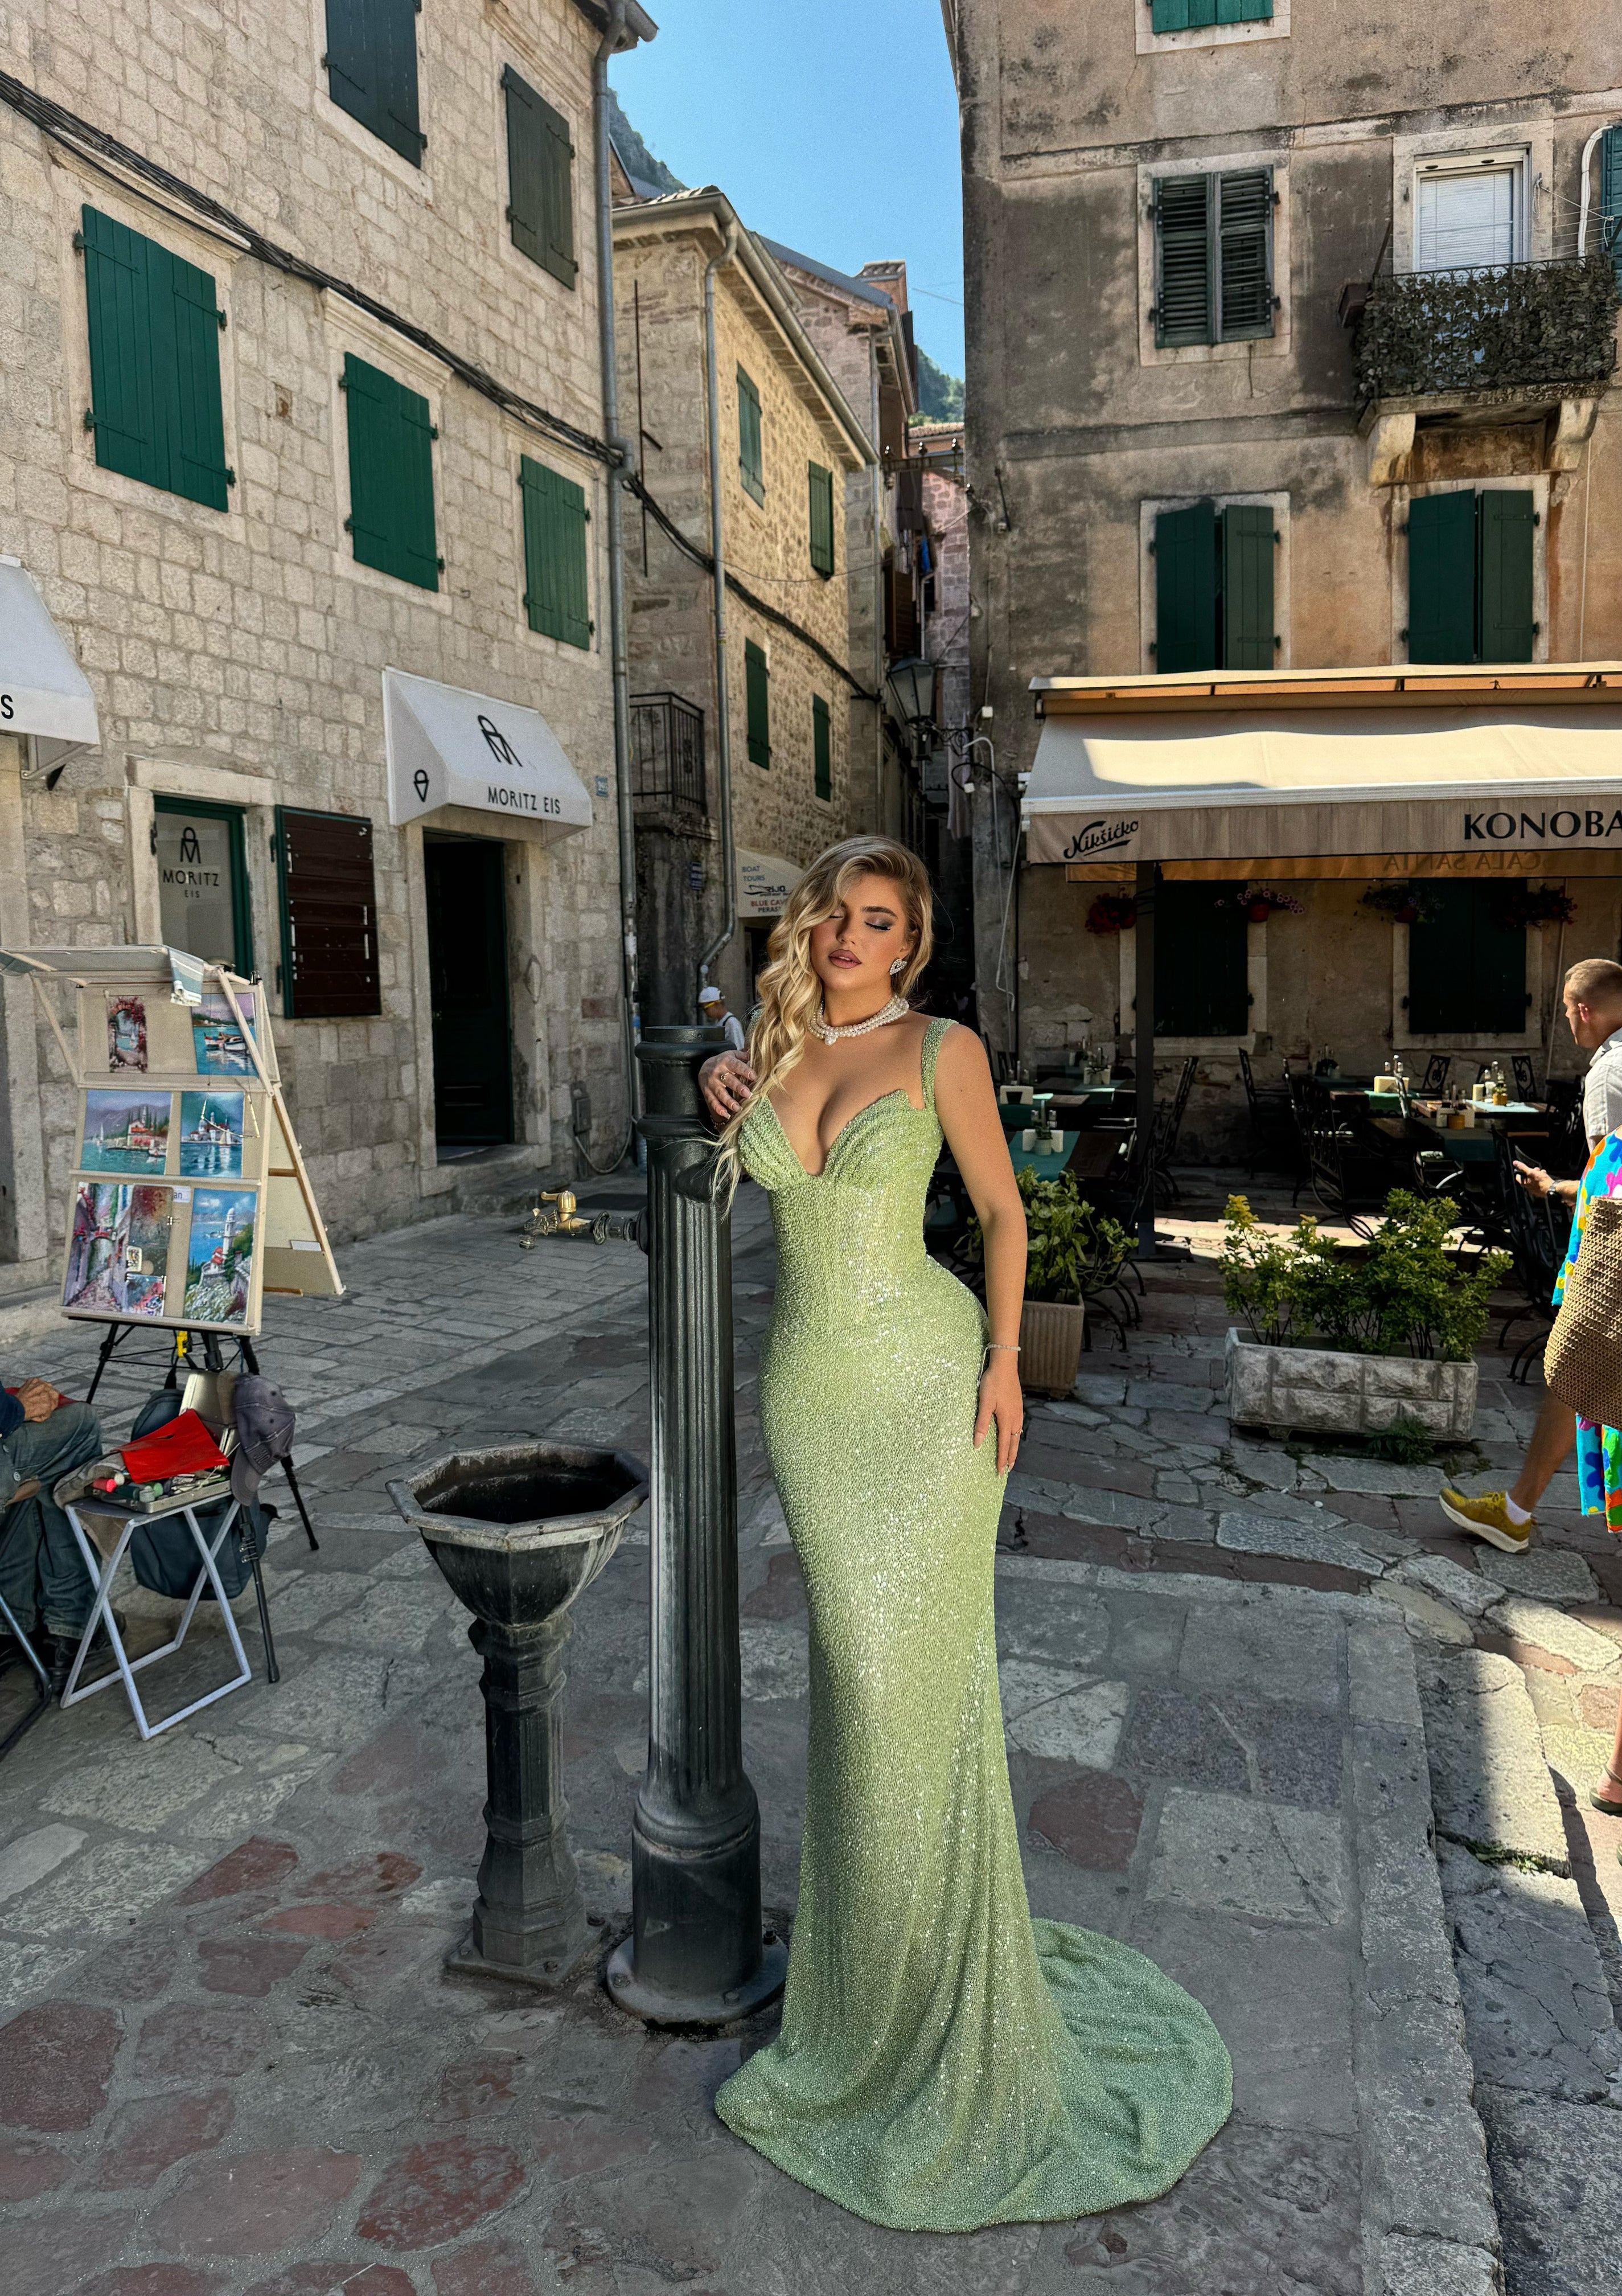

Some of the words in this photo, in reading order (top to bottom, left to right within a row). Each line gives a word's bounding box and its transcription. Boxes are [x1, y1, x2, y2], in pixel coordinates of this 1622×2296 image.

[487, 786, 537, 811] MORITZ
[544, 797, 561, 814] EIS
[1464, 810, 1622, 840] KONOBA
[1063, 821, 1139, 859] Nikšićko
[163, 870, 219, 887] MORITZ
[184, 889, 200, 899] EIS
